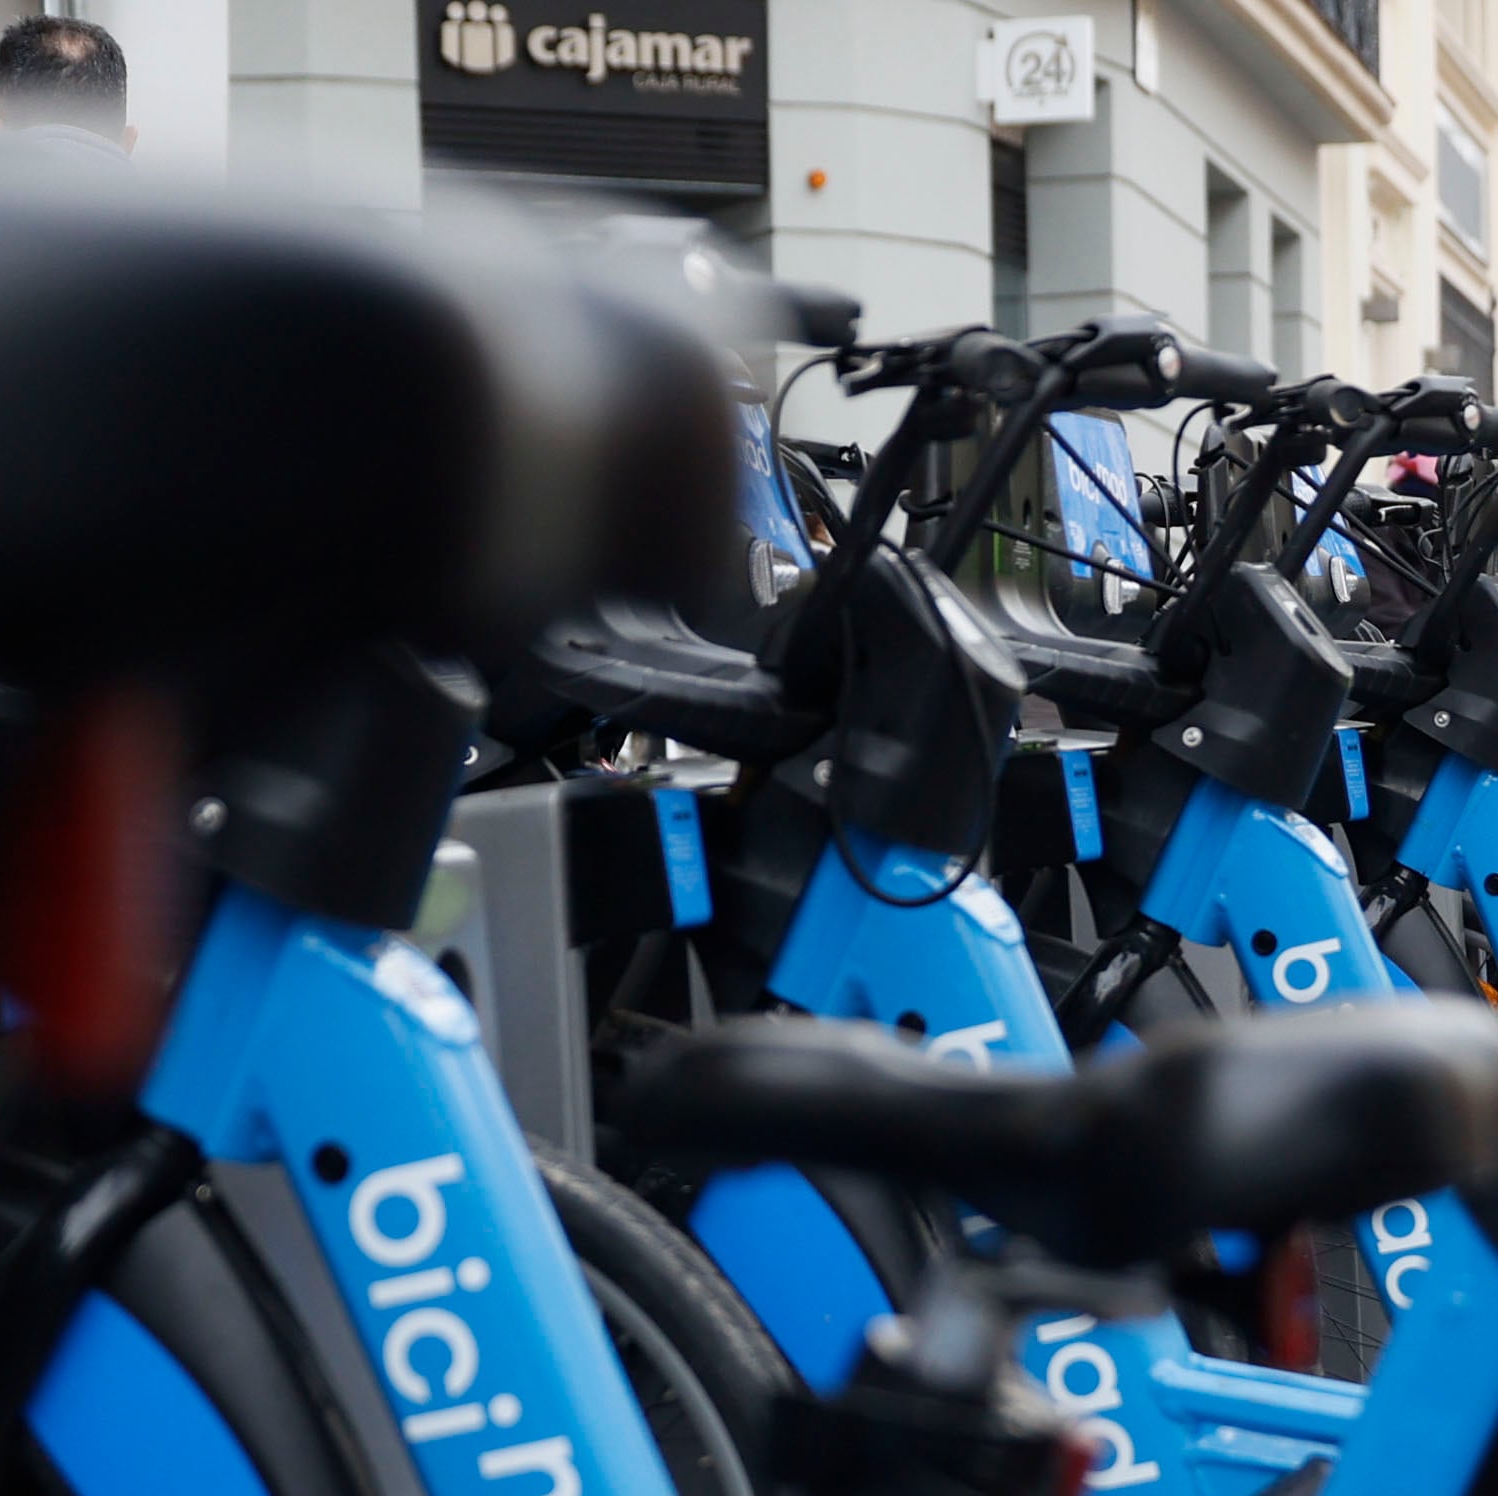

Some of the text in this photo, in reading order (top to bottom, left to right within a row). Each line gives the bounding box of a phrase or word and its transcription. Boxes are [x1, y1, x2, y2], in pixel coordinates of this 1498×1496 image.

[526, 12, 753, 84] cajamar
[631, 71, 741, 96] CAJA RURAL
[1021, 50, 1067, 86] 24
